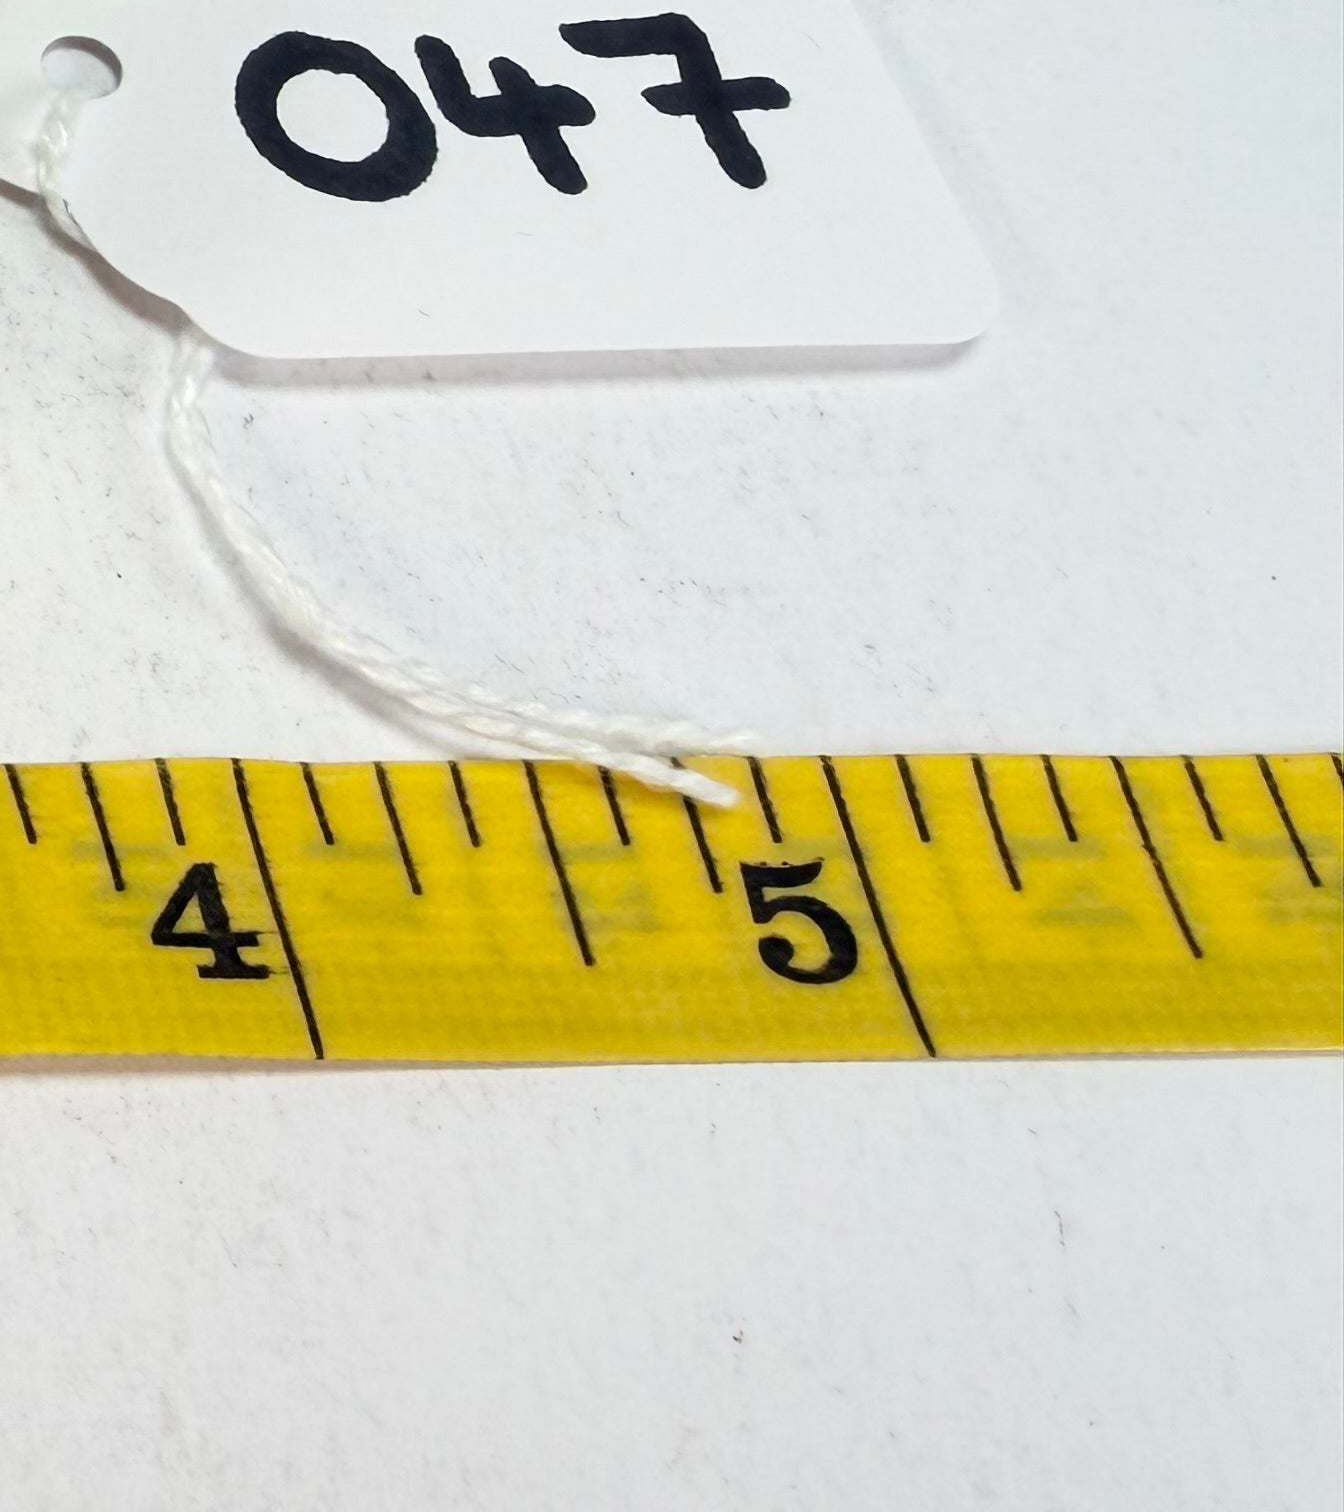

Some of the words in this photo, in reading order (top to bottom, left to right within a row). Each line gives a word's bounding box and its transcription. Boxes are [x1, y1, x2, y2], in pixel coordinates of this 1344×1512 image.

[235, 13, 791, 202] 047
[150, 862, 271, 979] 4
[740, 857, 859, 985] 5
